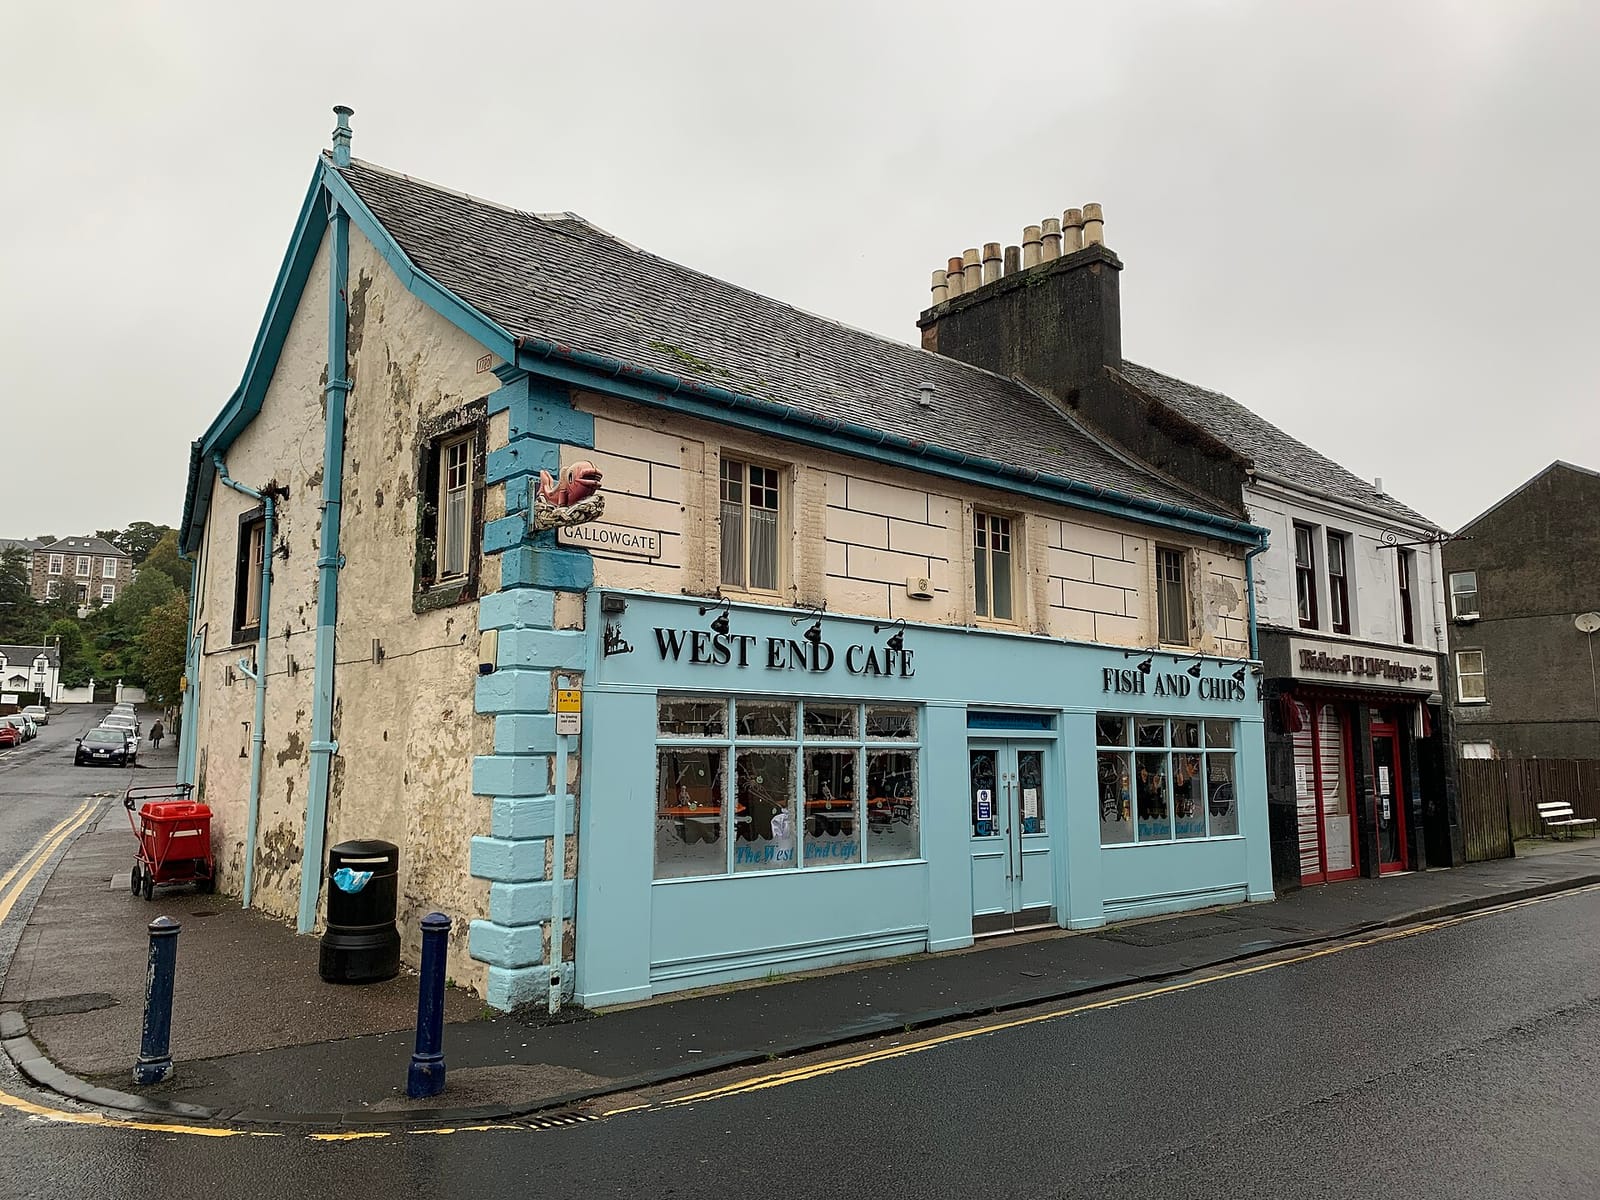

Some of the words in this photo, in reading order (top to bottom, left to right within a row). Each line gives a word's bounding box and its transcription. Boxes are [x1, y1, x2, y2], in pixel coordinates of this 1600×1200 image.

[564, 526, 655, 550] GALLOWGATE
[653, 627, 756, 667] WEST
[766, 637, 834, 672] END
[846, 644, 915, 677] CAFE
[1103, 668, 1145, 694] FISH
[1154, 673, 1190, 697] AND
[1199, 678, 1245, 701] CHIPS
[736, 845, 760, 864] The
[763, 844, 793, 862] West
[804, 842, 830, 859] End
